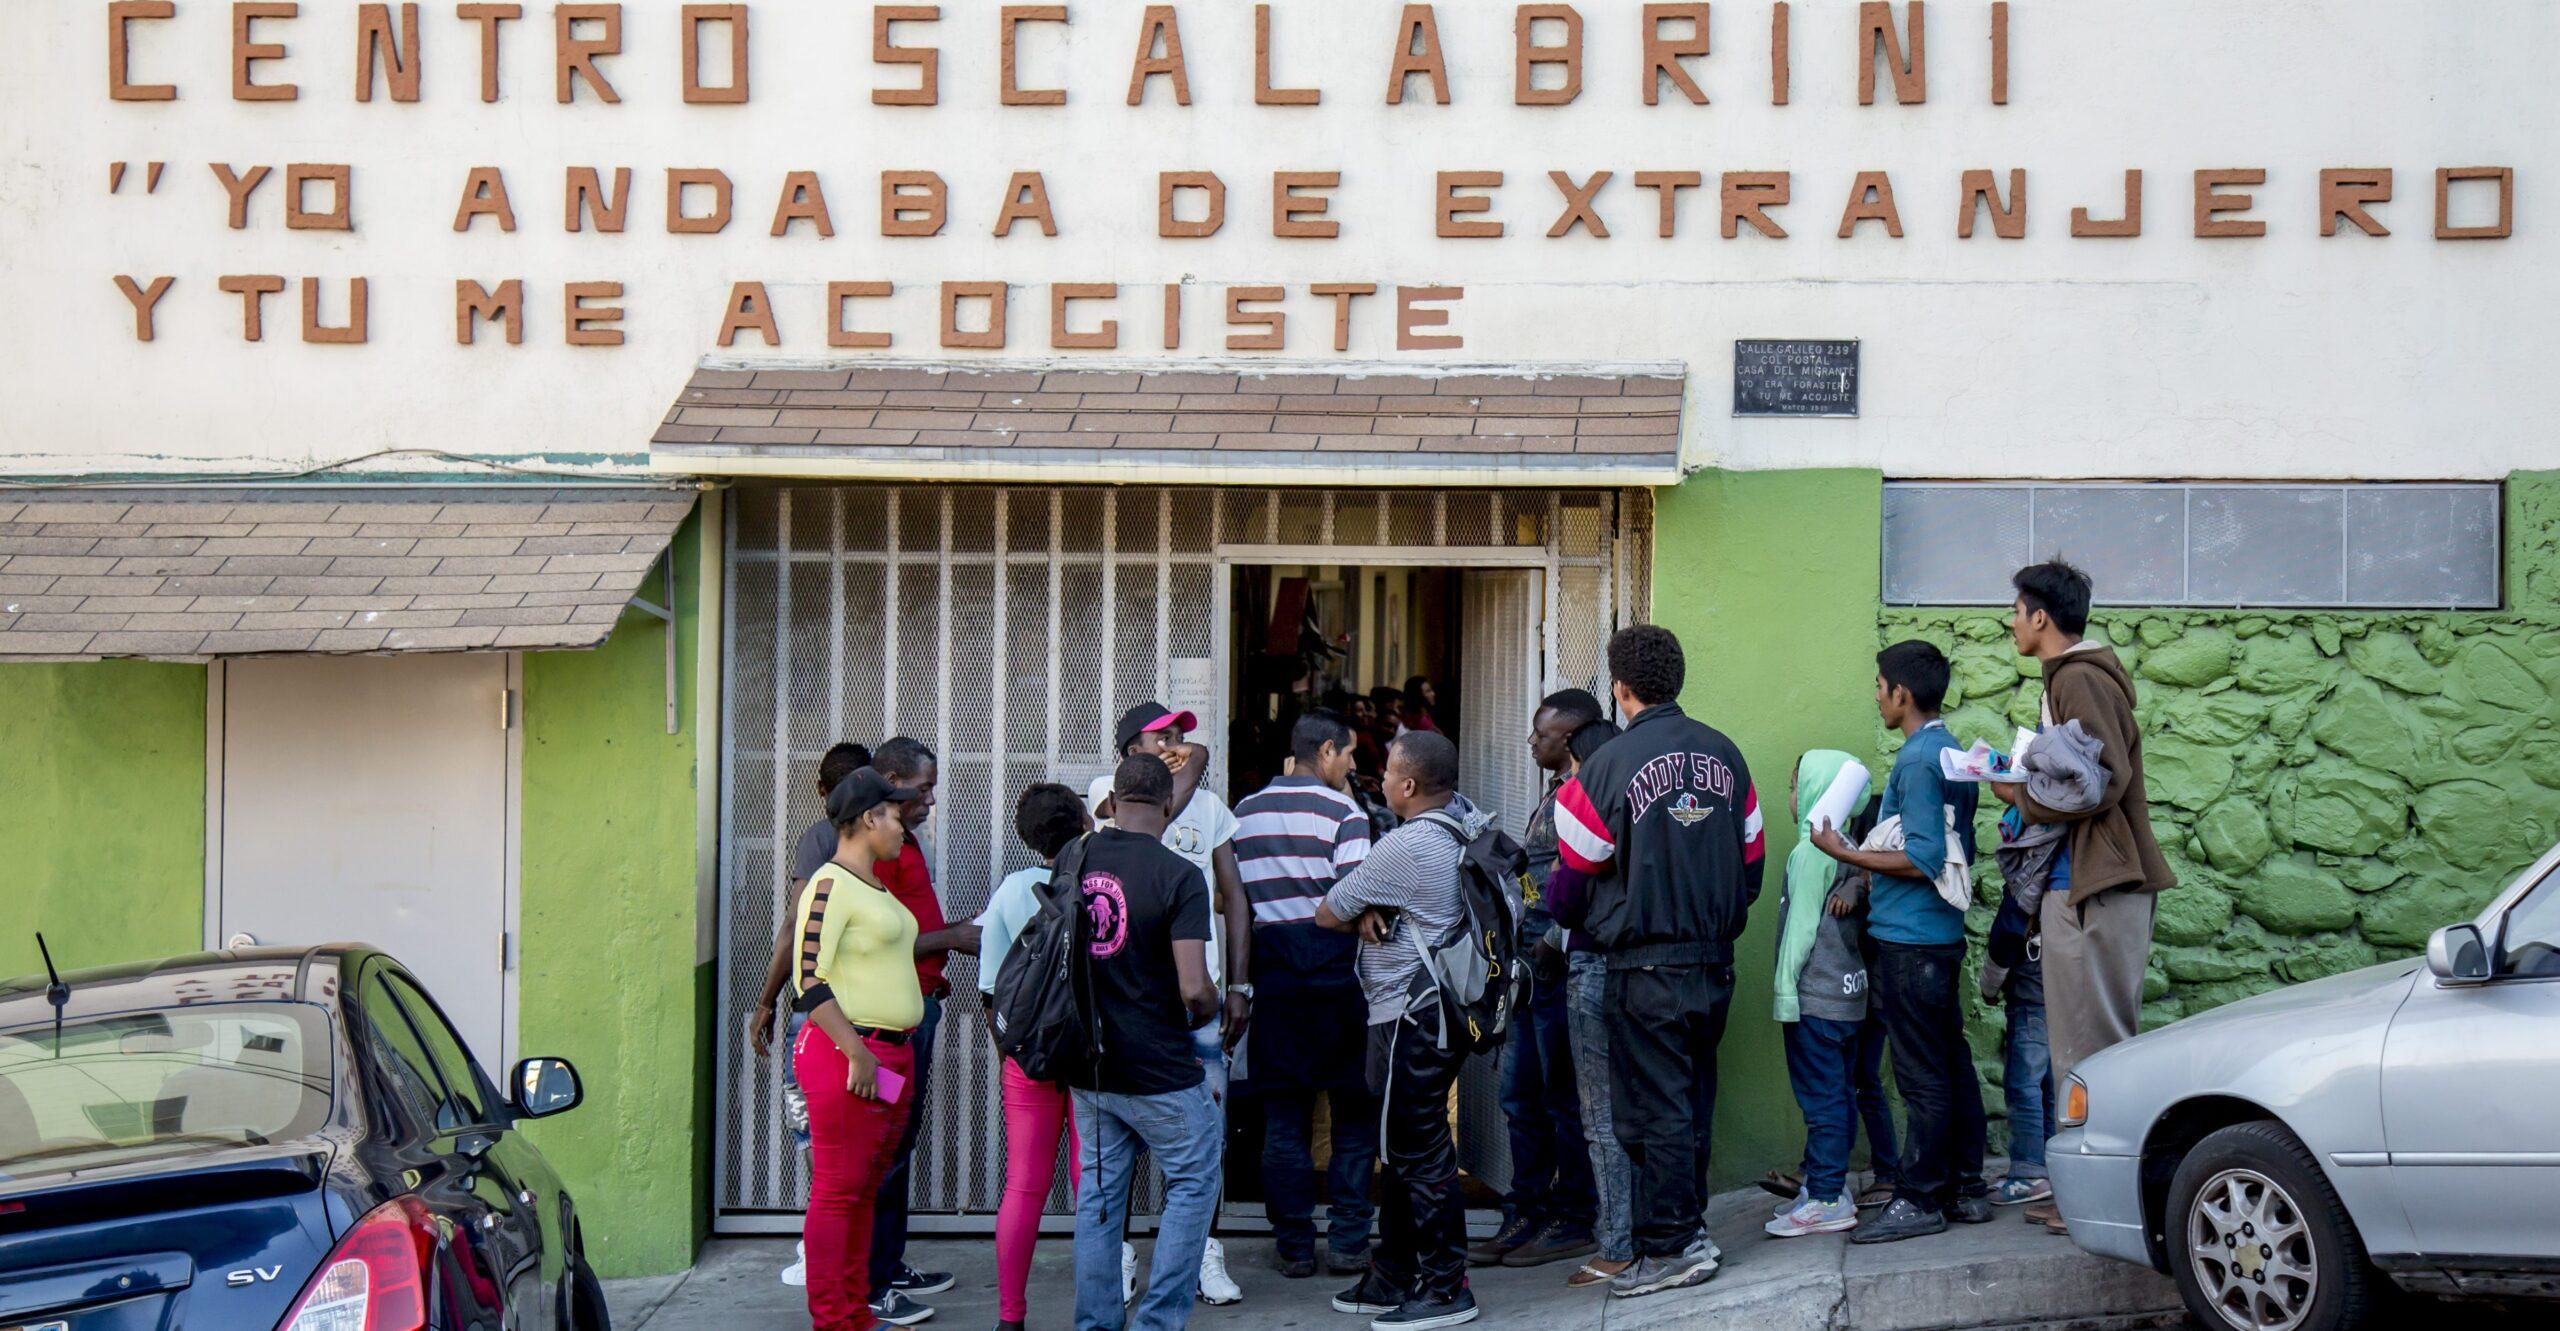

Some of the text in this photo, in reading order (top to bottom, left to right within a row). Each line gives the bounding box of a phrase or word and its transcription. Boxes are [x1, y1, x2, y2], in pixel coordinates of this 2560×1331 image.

[108, 0, 2009, 108] CENTRO SCALABRINI
[452, 165, 1057, 240] ANDABA
[1158, 170, 1340, 240] DE
[1435, 166, 2514, 240] EXTRANJERO
[455, 278, 624, 349] ME
[715, 280, 1464, 353] ACOGISTE
[1739, 344, 1849, 355] CALLE GALILEO 239
[1760, 355, 1830, 365] COL POSTAL
[1737, 365, 1855, 377] CASA DEL MIGRANTE
[1741, 379, 1754, 389] YO
[1764, 380, 1783, 389] ERA
[1741, 391, 1850, 402] Y TU ME ACOJISTE
[1626, 752, 1685, 824] INDY
[226, 1263, 284, 1287] SV
